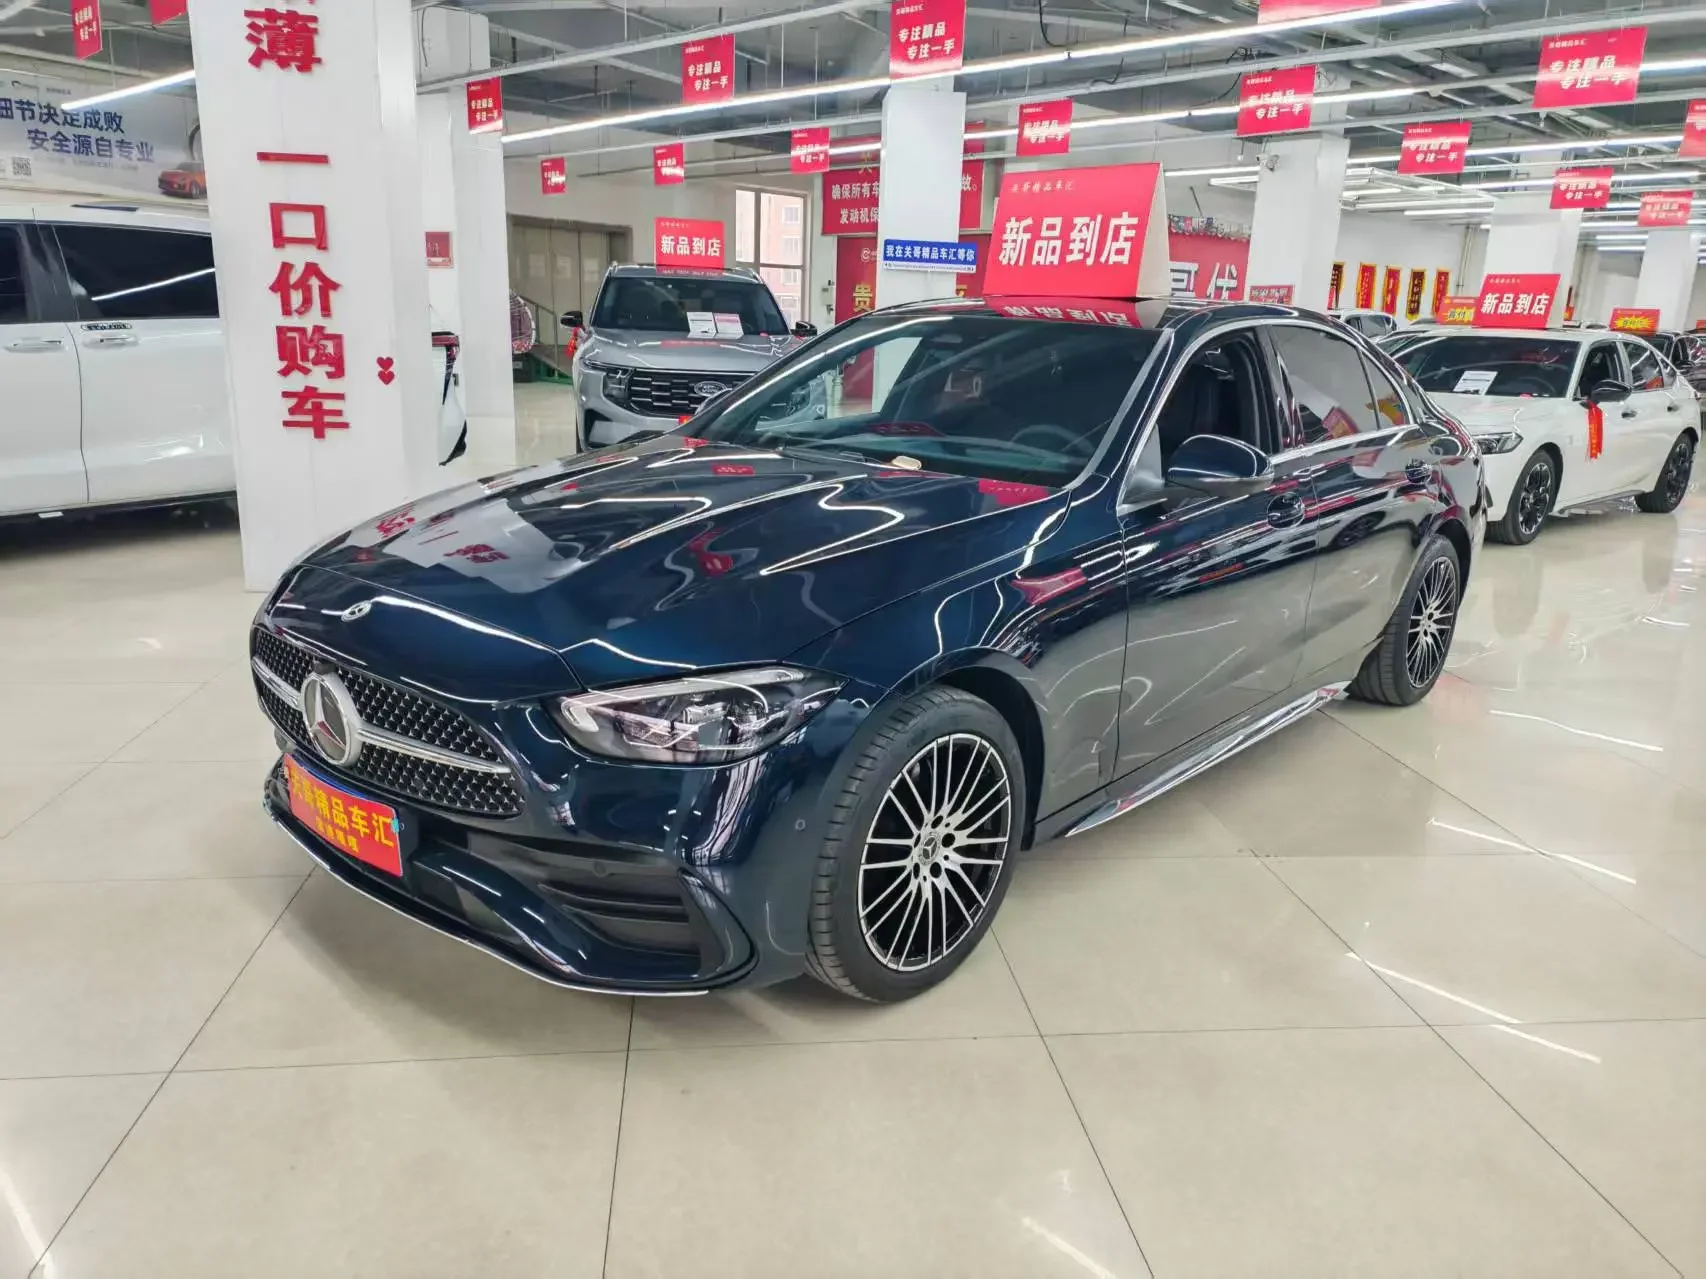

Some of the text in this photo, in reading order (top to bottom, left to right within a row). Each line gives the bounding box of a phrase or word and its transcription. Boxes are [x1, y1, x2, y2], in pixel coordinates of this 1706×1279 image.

[27, 128, 154, 163] 安全源自专业
[661, 234, 721, 257] 新品到店
[999, 211, 1139, 267] 新品到店
[256, 151, 351, 440] 一口价购车
[1481, 292, 1550, 315] 新品到店
